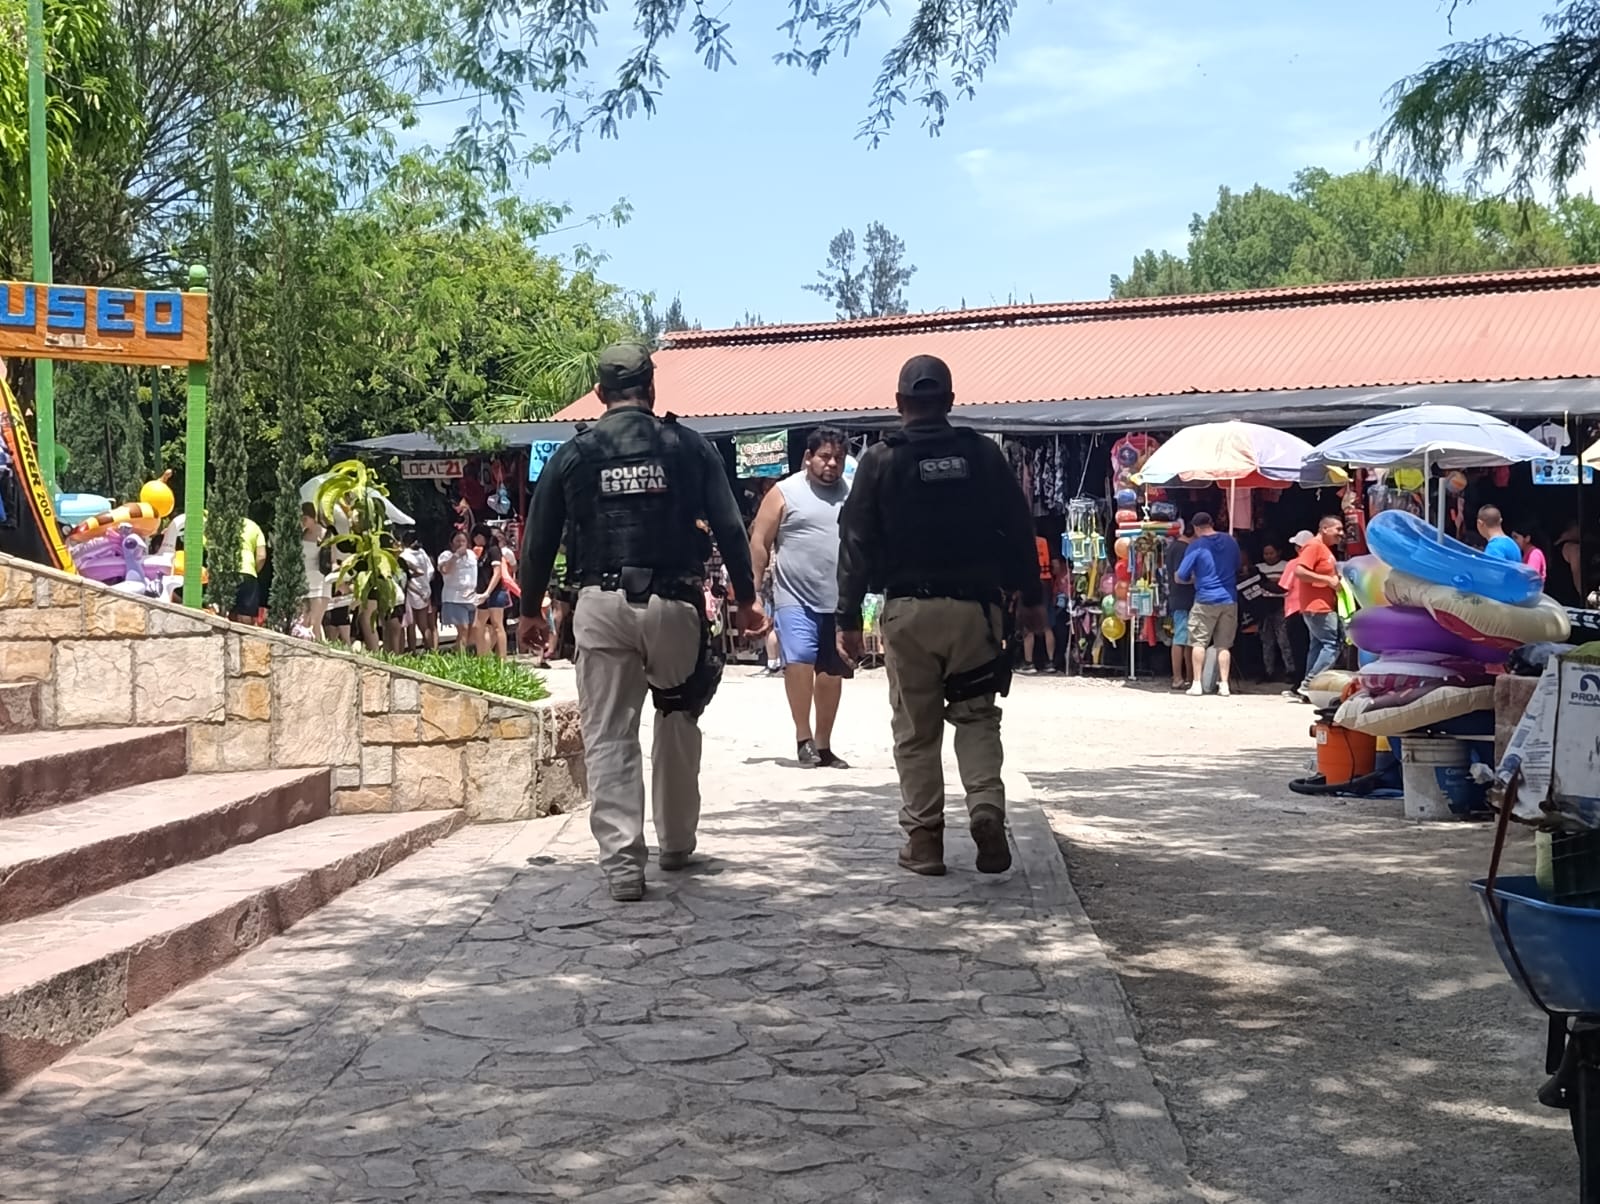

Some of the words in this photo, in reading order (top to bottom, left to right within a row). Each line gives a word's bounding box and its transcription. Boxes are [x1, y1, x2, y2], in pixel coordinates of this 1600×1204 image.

[402, 462, 445, 476] LOCAL
[445, 460, 462, 476] 21
[600, 465, 665, 481] POLICIA
[1557, 465, 1570, 476] 26
[601, 478, 667, 493] ESTATAL
[36, 491, 52, 518] 200
